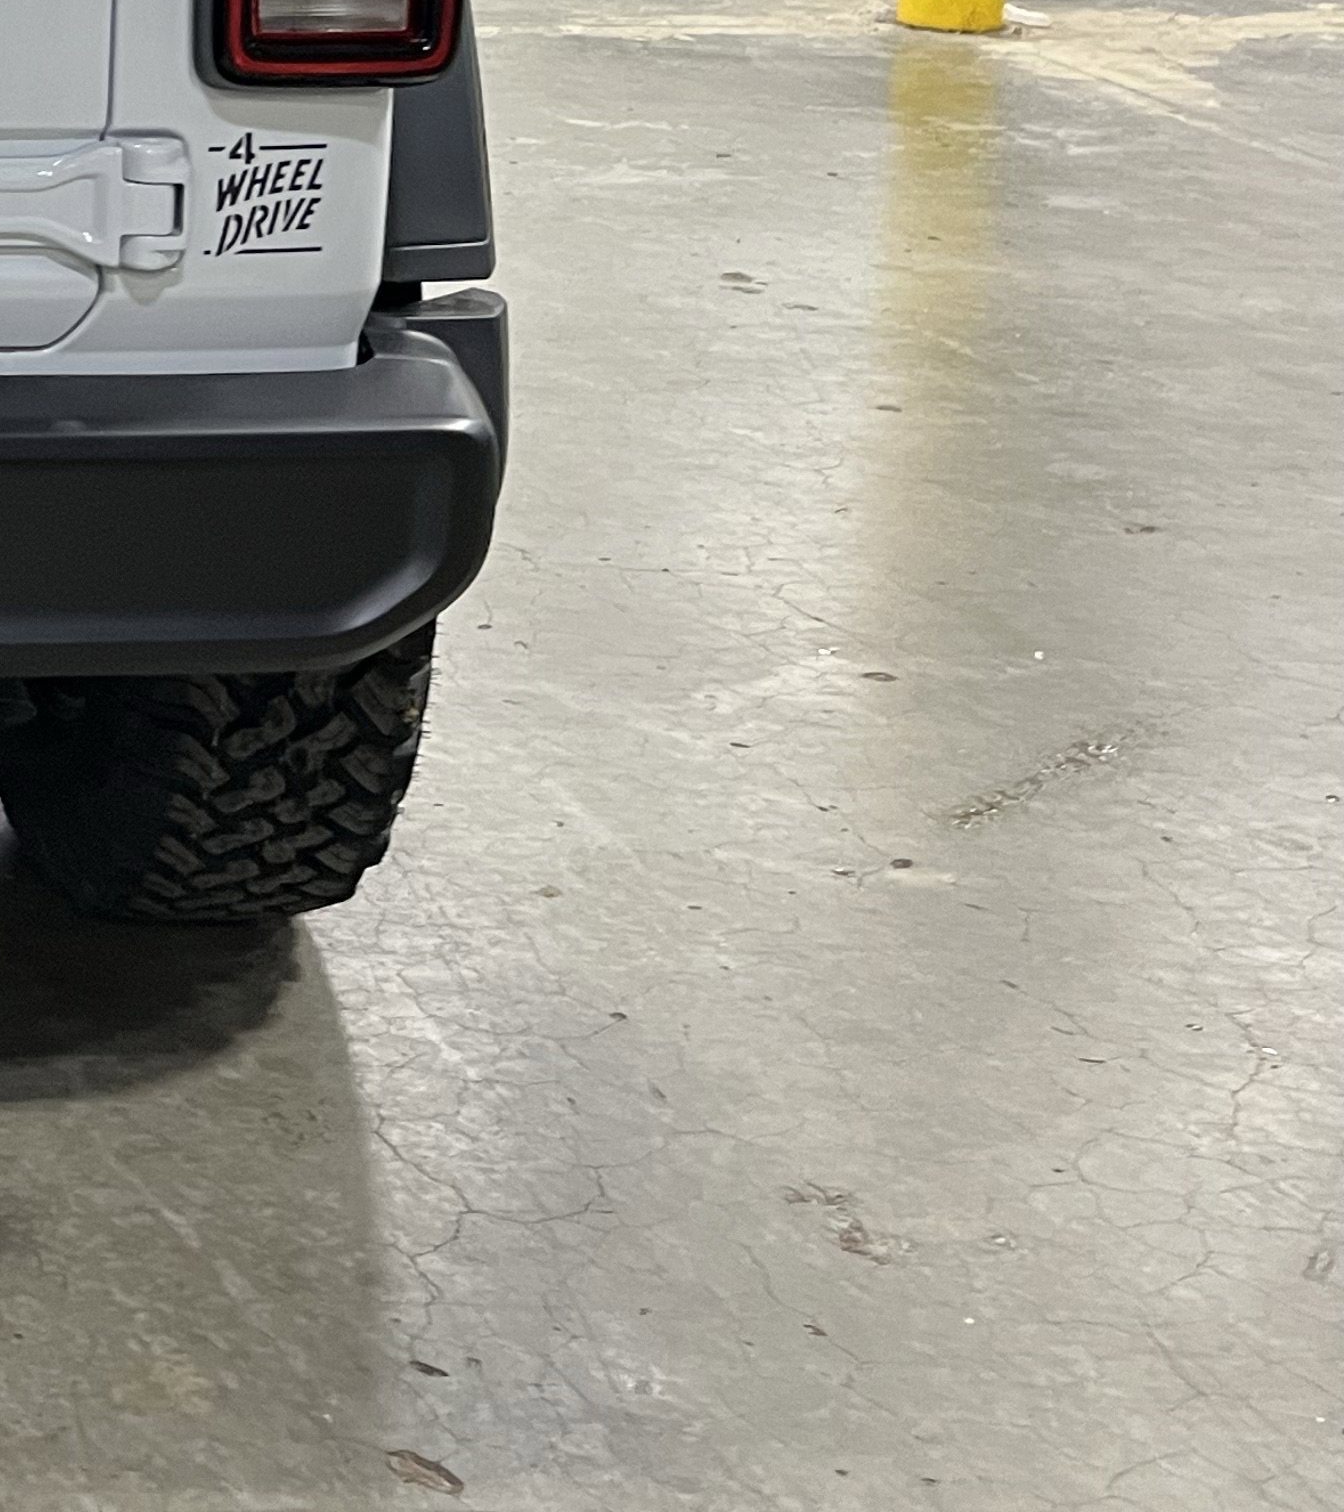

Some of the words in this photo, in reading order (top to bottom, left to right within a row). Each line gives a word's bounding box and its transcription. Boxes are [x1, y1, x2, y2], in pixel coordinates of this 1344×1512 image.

[228, 132, 256, 165] 4
[215, 159, 324, 212] WHEEL
[214, 197, 322, 257] DRIVE
